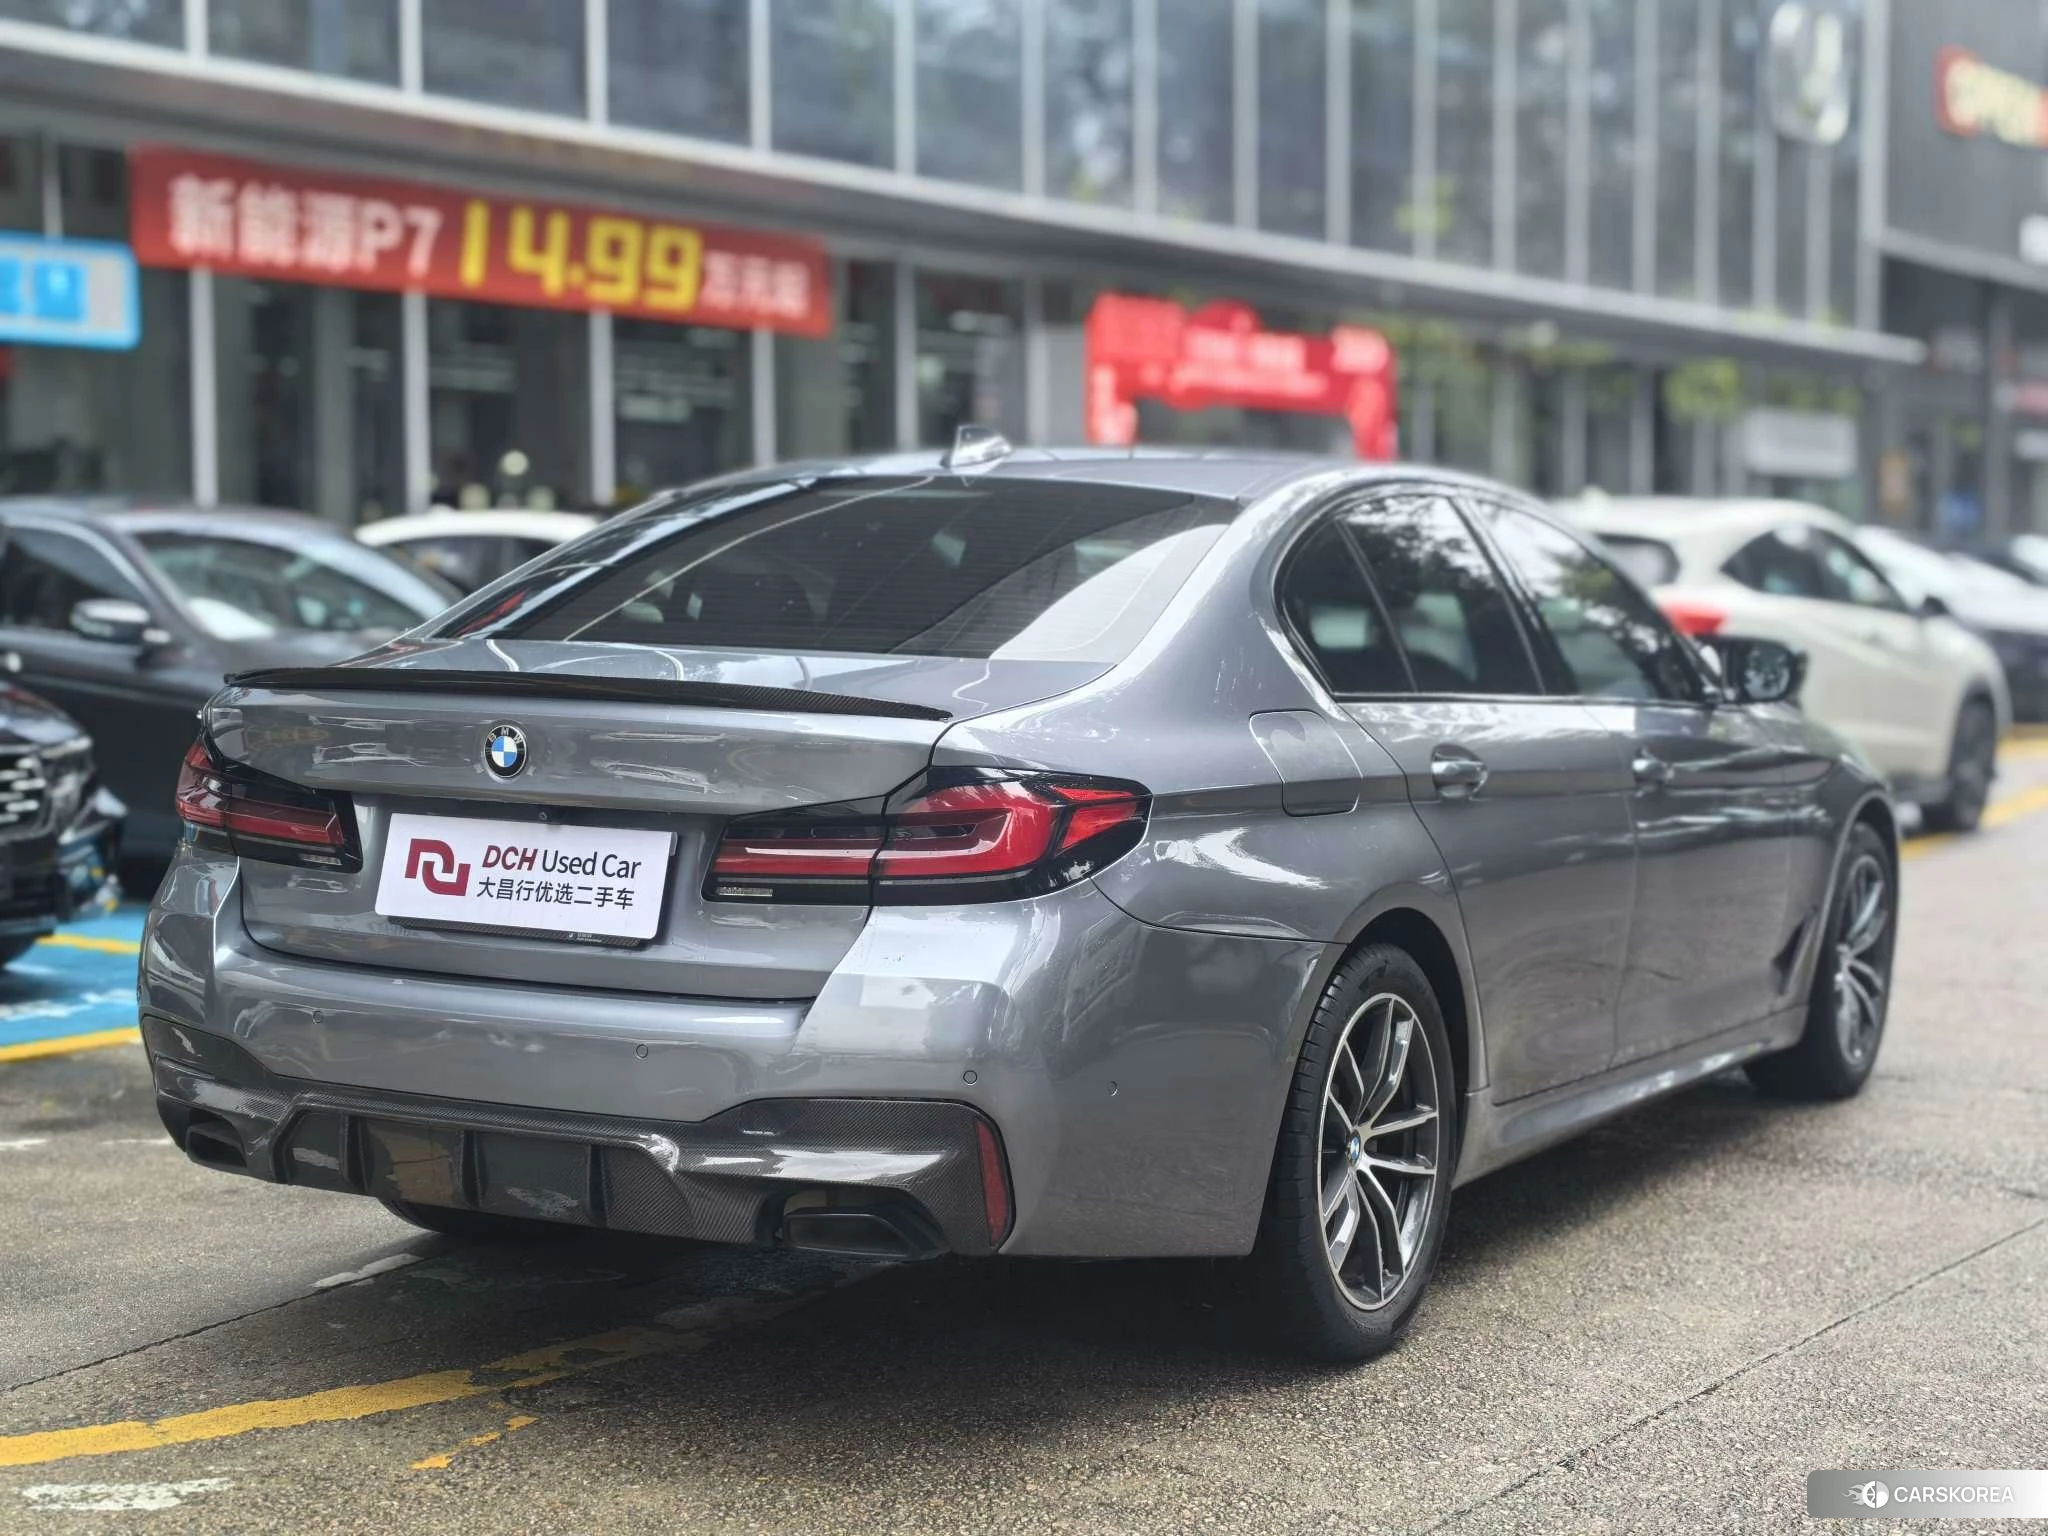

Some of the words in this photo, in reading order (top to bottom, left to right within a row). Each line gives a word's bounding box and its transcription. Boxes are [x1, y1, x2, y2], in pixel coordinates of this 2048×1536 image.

[460, 199, 702, 314] 14.99
[482, 845, 538, 871] DCH
[542, 849, 598, 876] Used
[601, 854, 642, 879] Car
[476, 876, 635, 910] 大昌行优选二手车
